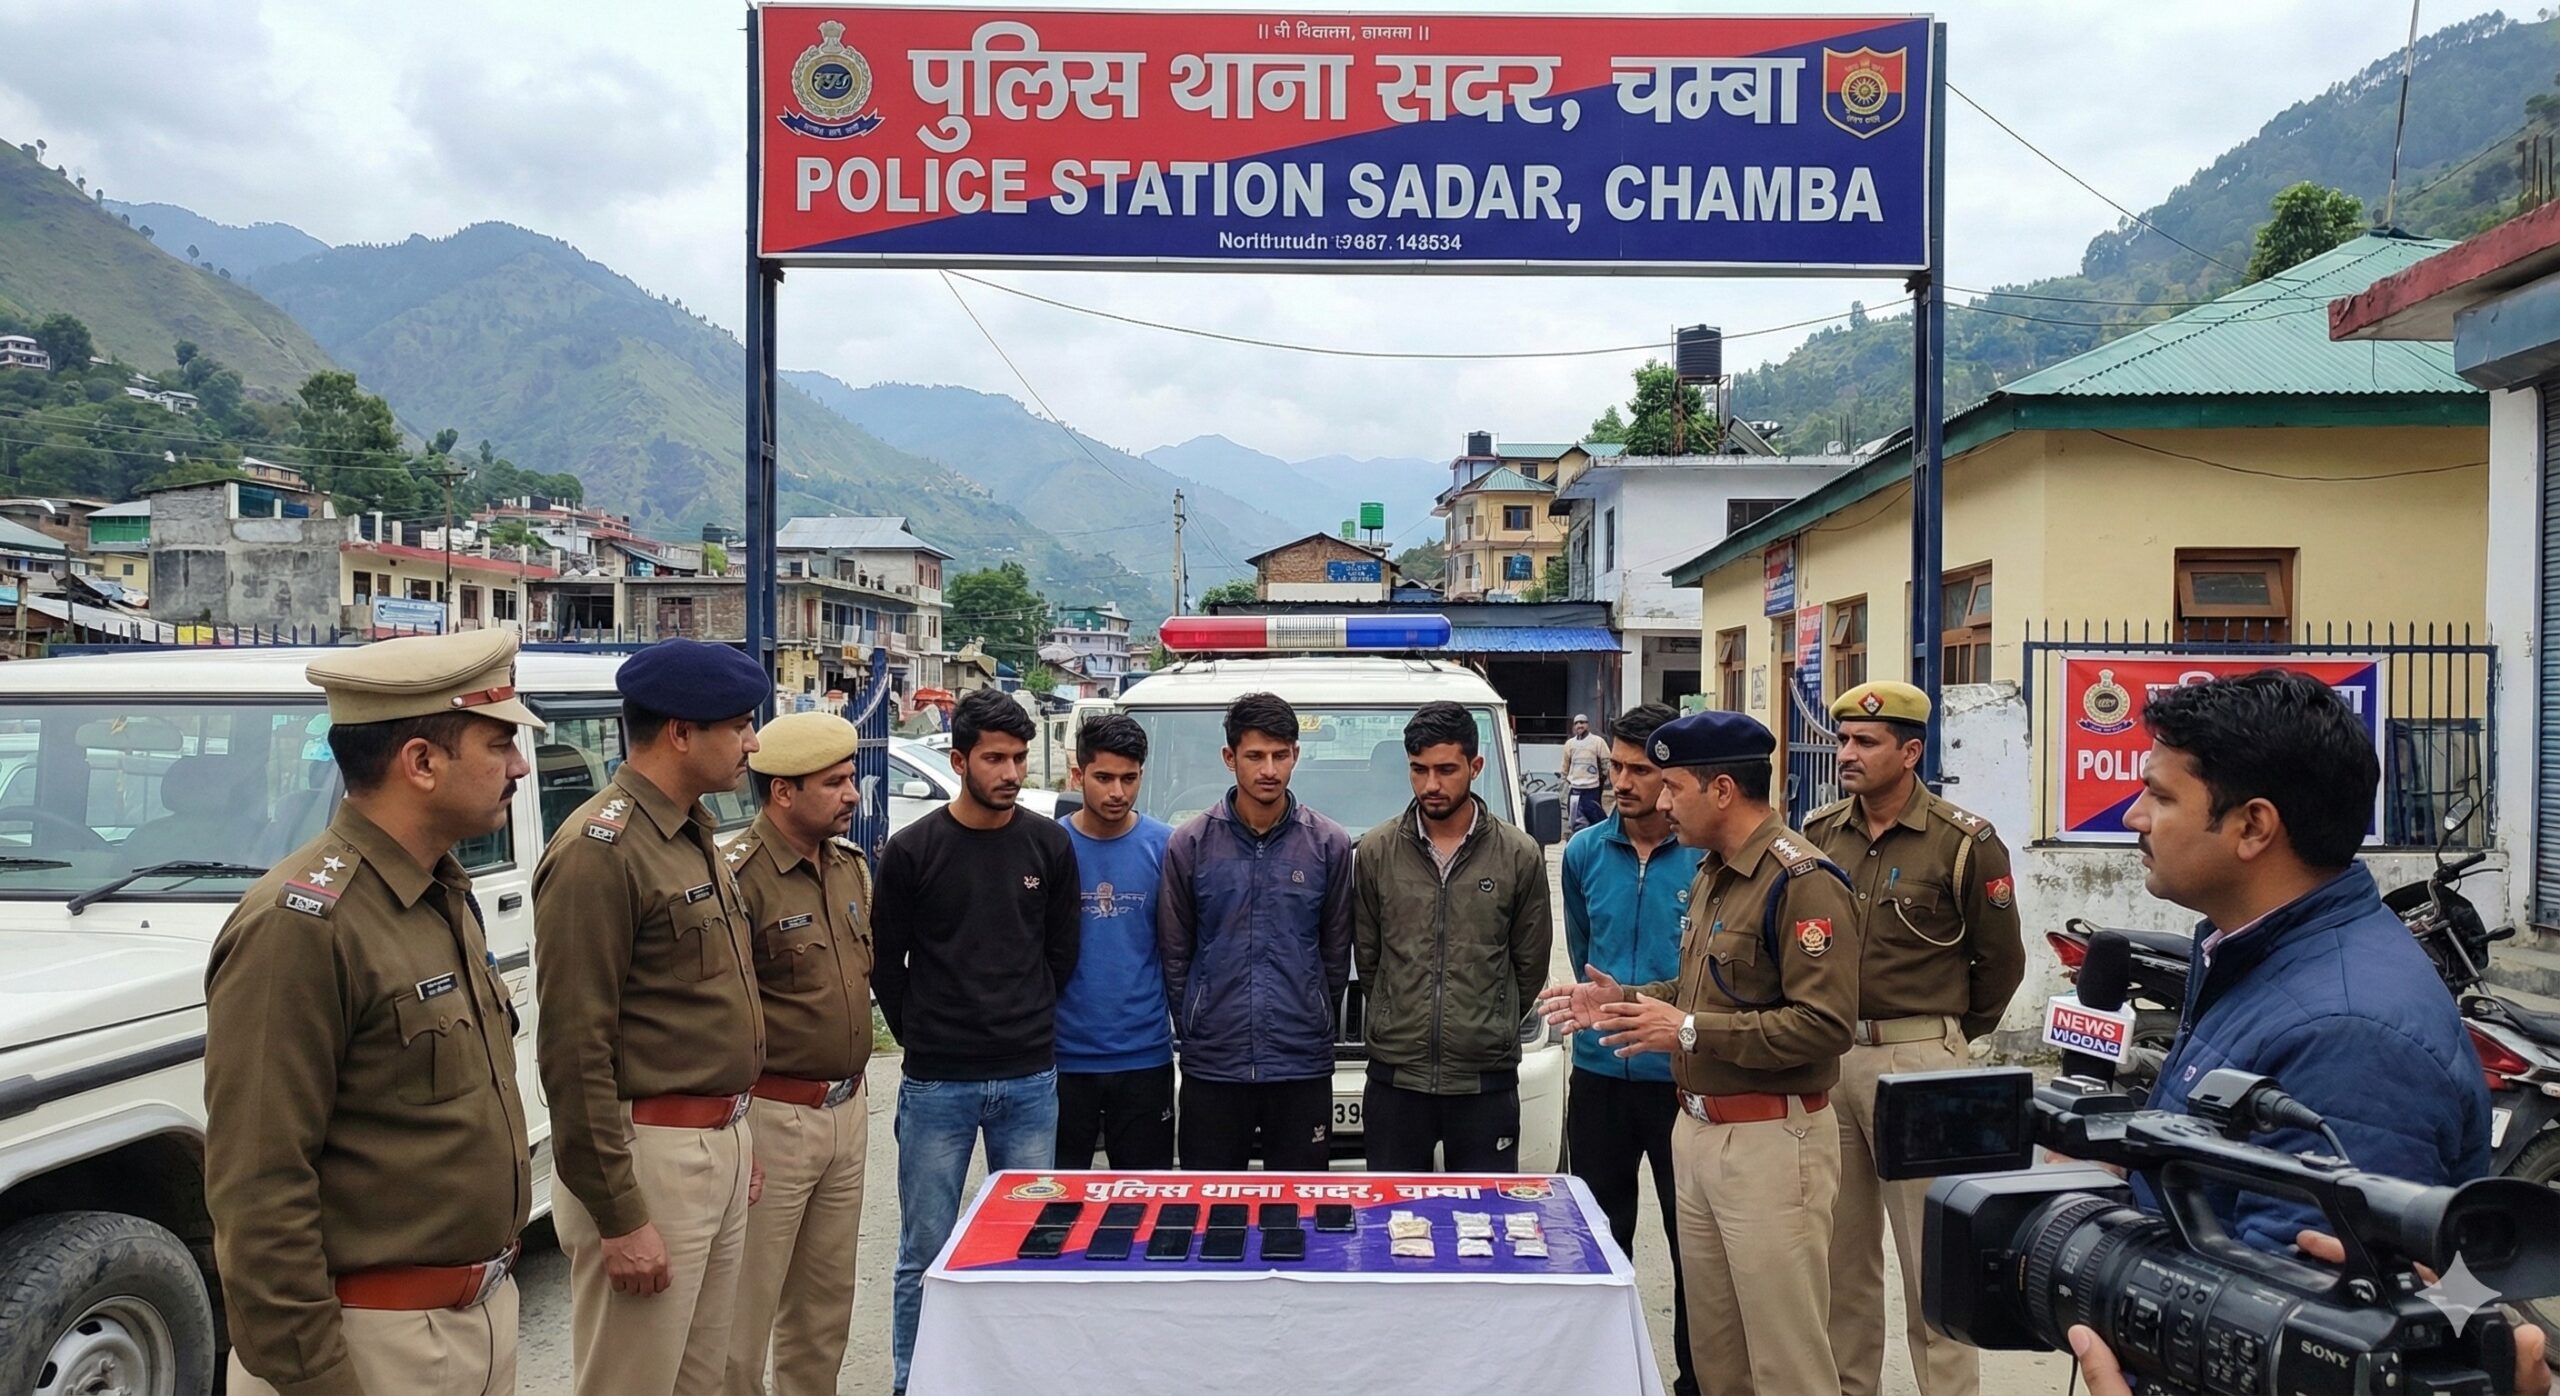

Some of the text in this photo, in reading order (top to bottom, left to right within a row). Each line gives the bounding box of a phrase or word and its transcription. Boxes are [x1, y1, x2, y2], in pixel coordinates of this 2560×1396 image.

[907, 20, 1806, 154] पुलिस थाना सदर, चम्बा
[796, 156, 1884, 231] POLICE STATION SADAR, CHAMBA
[2057, 1010, 2116, 1039] NEWS
[1084, 1179, 1193, 1202] पुलिस
[1201, 1183, 1285, 1199] थाना
[1293, 1184, 1384, 1202] सदर,
[2301, 1340, 2350, 1369] SONY
